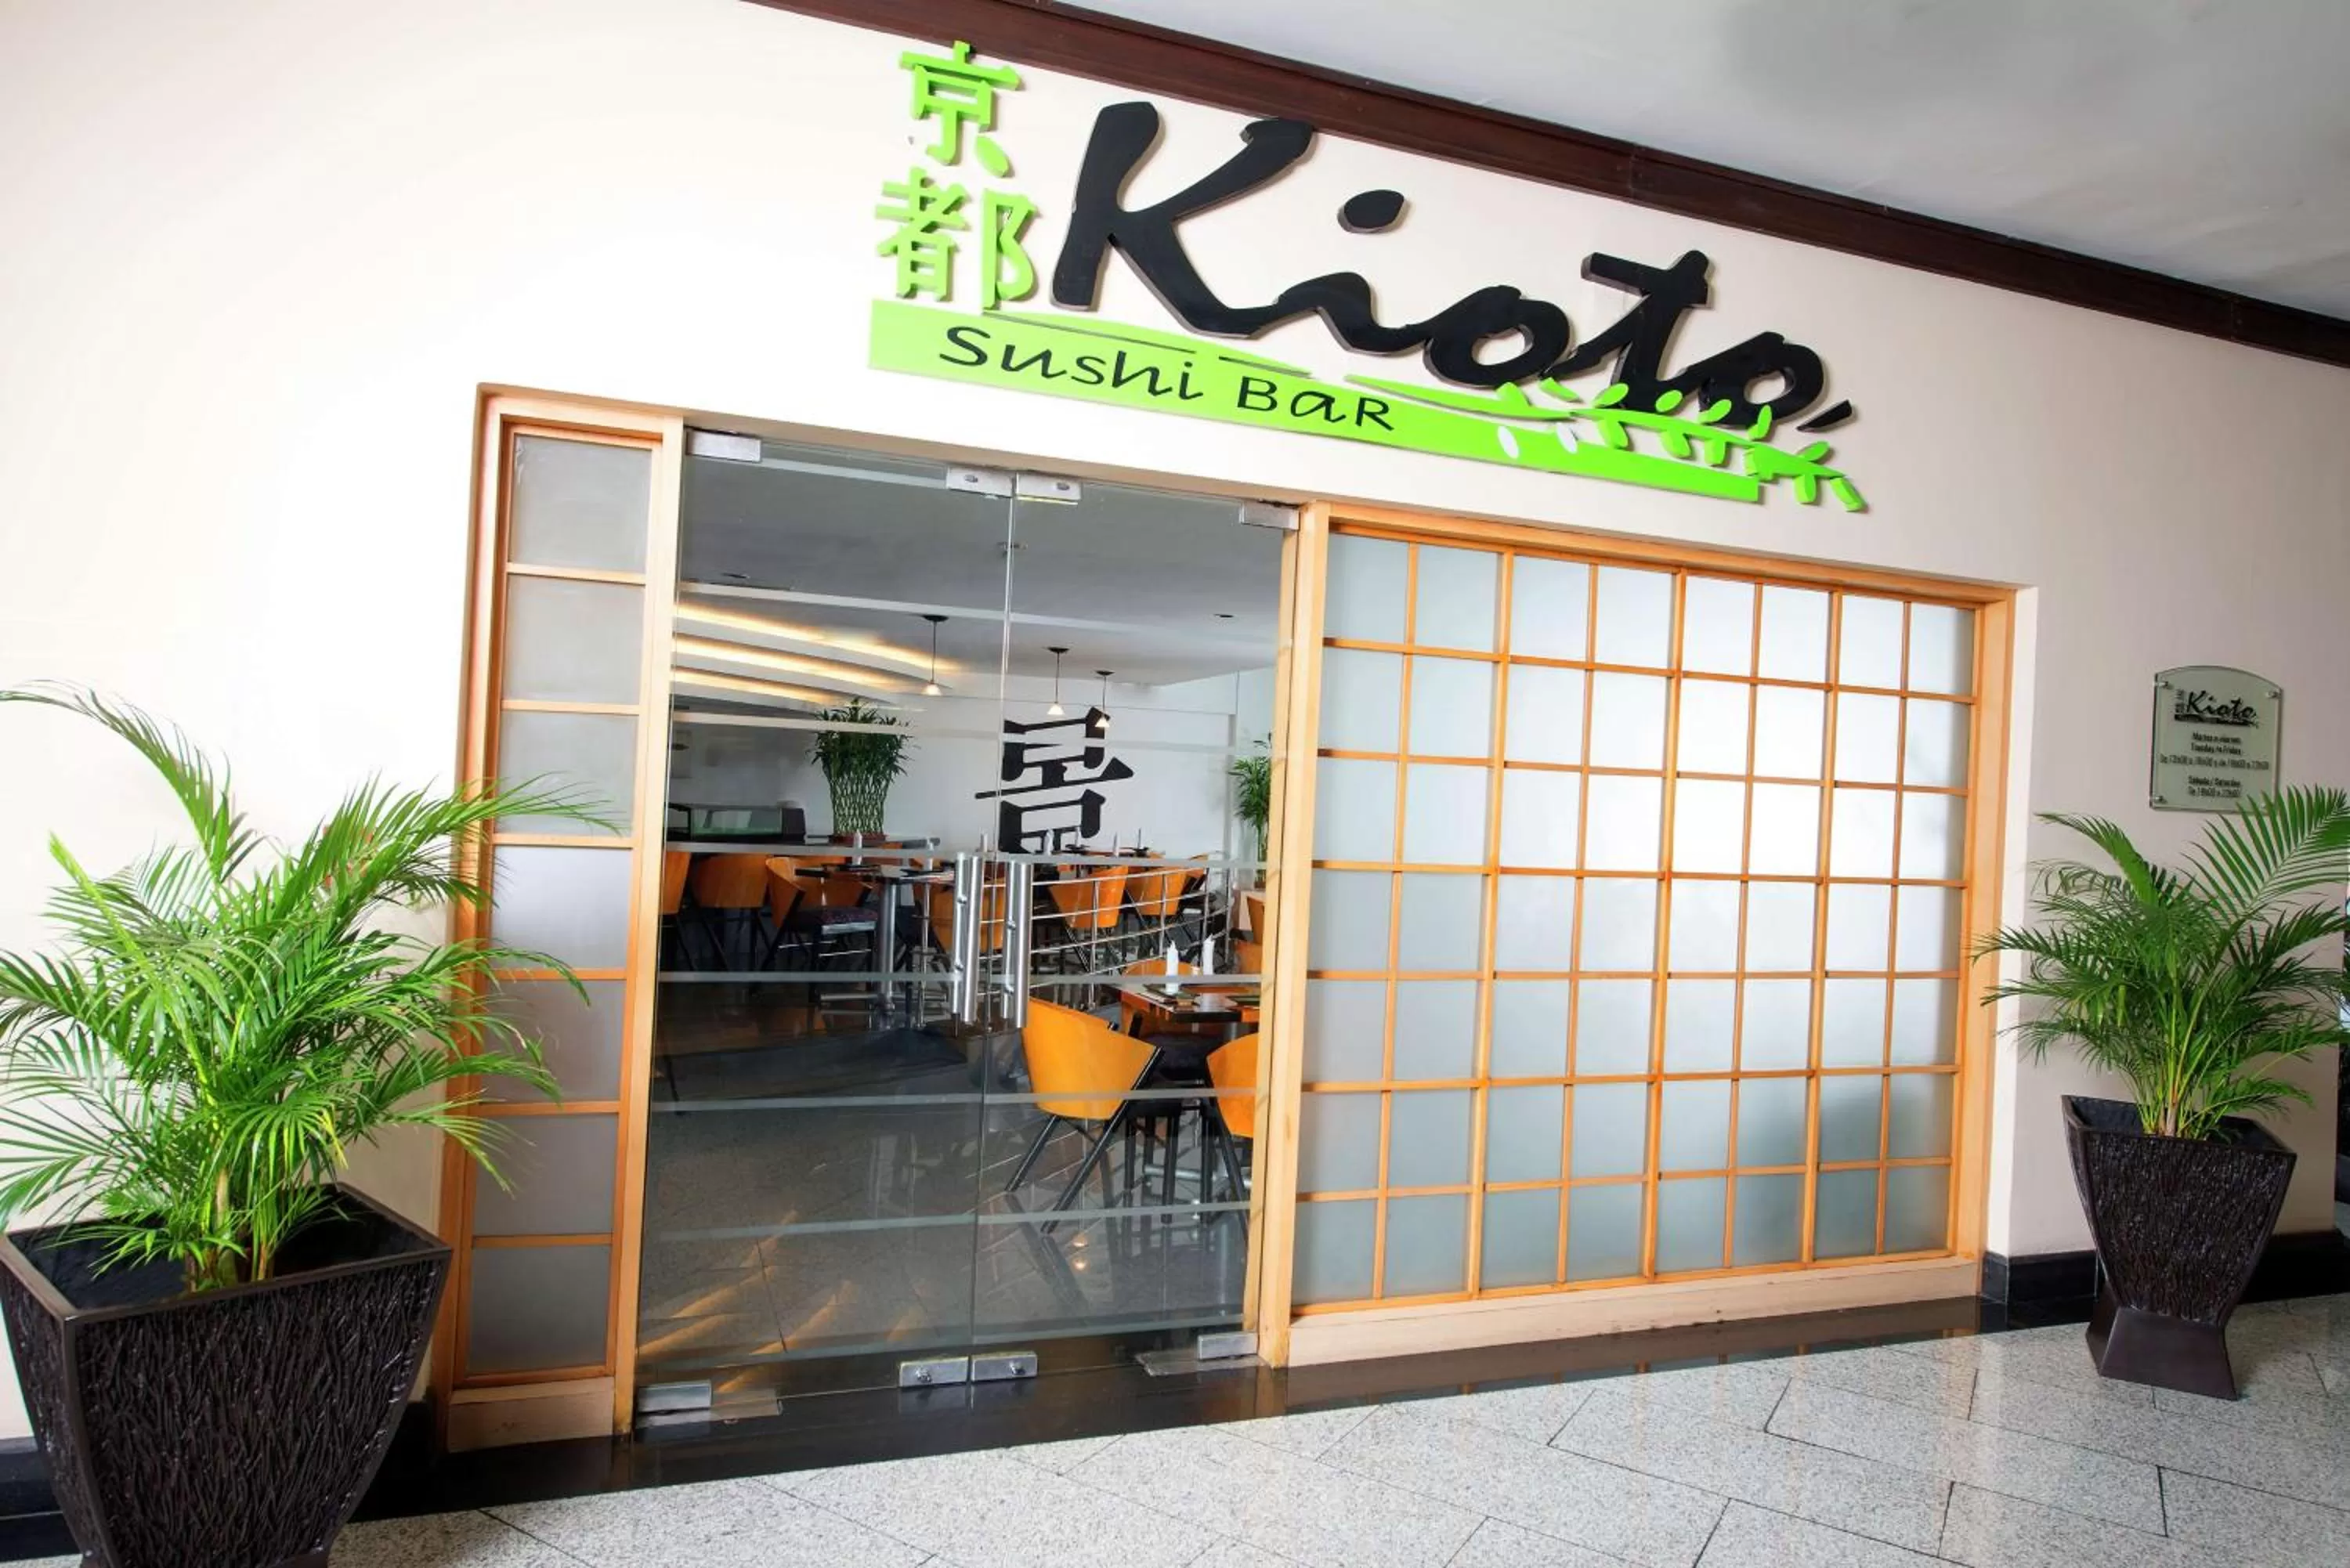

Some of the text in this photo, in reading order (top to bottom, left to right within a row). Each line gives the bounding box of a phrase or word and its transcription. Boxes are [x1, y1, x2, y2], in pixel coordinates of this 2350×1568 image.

[873, 40, 1036, 313] 京都
[1049, 100, 1853, 431] Kioto
[939, 325, 1203, 401] Sushi
